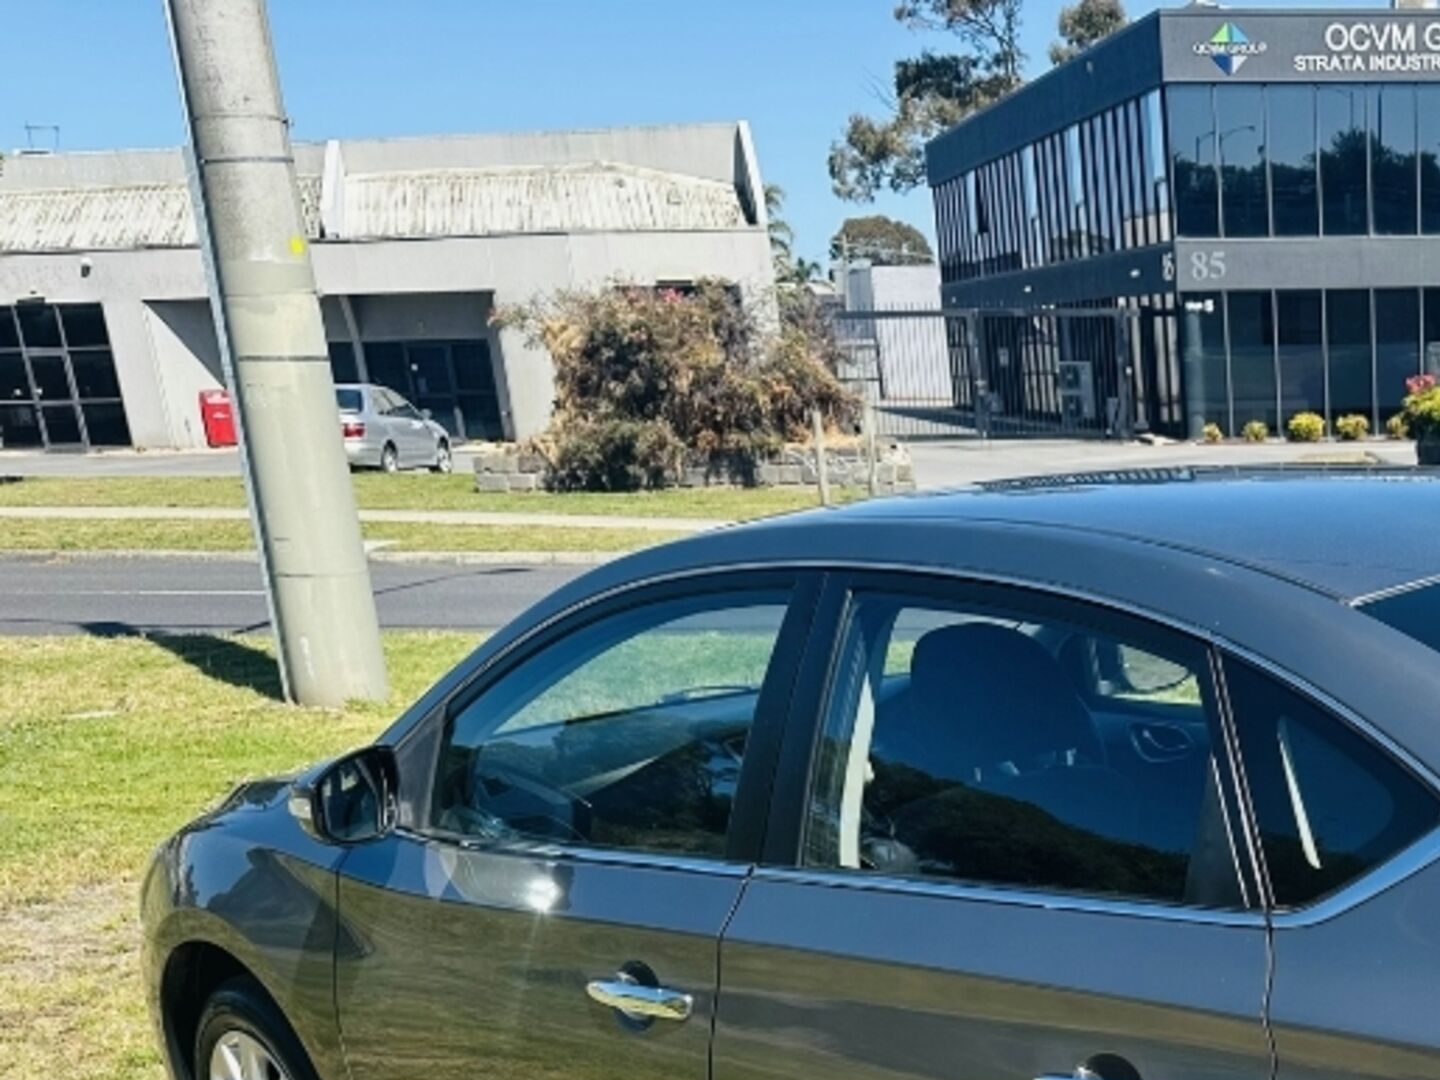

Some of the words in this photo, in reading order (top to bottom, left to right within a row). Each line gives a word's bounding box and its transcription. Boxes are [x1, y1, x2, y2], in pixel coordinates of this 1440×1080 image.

[1325, 22, 1416, 52] OCVM
[1294, 54, 1366, 72] STRATA
[1190, 251, 1226, 281] 85
